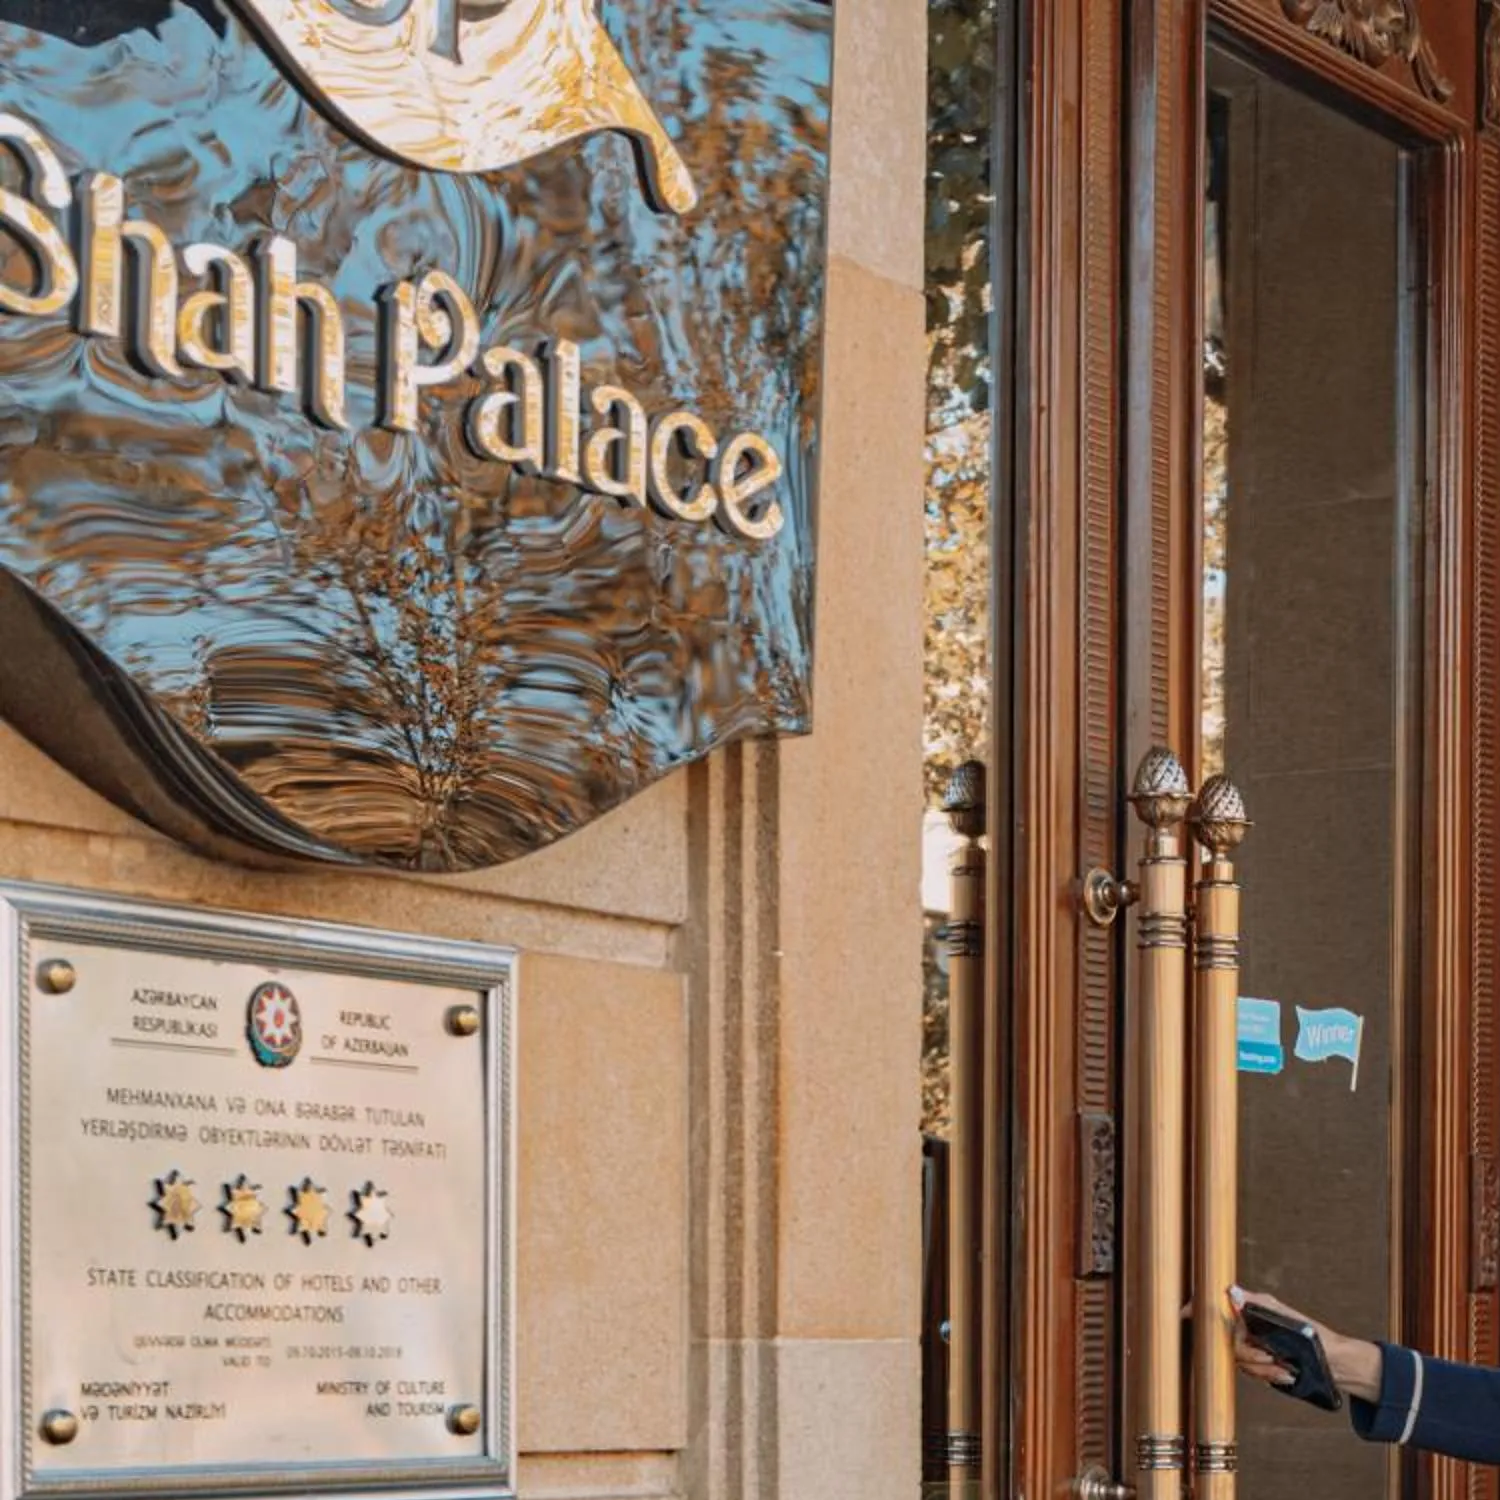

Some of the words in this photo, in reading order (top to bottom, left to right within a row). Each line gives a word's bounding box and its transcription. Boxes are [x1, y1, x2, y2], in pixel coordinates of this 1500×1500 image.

[0, 113, 353, 430] Shah
[388, 270, 785, 541] Palace
[339, 1010, 391, 1030] REPUBLIC
[321, 1034, 336, 1050] OF
[106, 1087, 217, 1112] MEHMANXANA
[254, 1099, 286, 1116] ONA
[365, 1106, 425, 1128] TUTULAN
[87, 1267, 137, 1287] STATE
[145, 1269, 265, 1289] CLASSIFICATION
[273, 1273, 293, 1291] OF
[301, 1274, 353, 1293] HOTELS
[361, 1276, 391, 1294] AND
[398, 1277, 442, 1294] OTHER
[204, 1303, 344, 1323] ACCOMMODATIONS
[317, 1380, 369, 1395] MINISTRY
[375, 1380, 391, 1395] OF
[396, 1380, 446, 1395] CULTURE
[366, 1402, 391, 1417] AND
[397, 1402, 445, 1416] TOURISM
